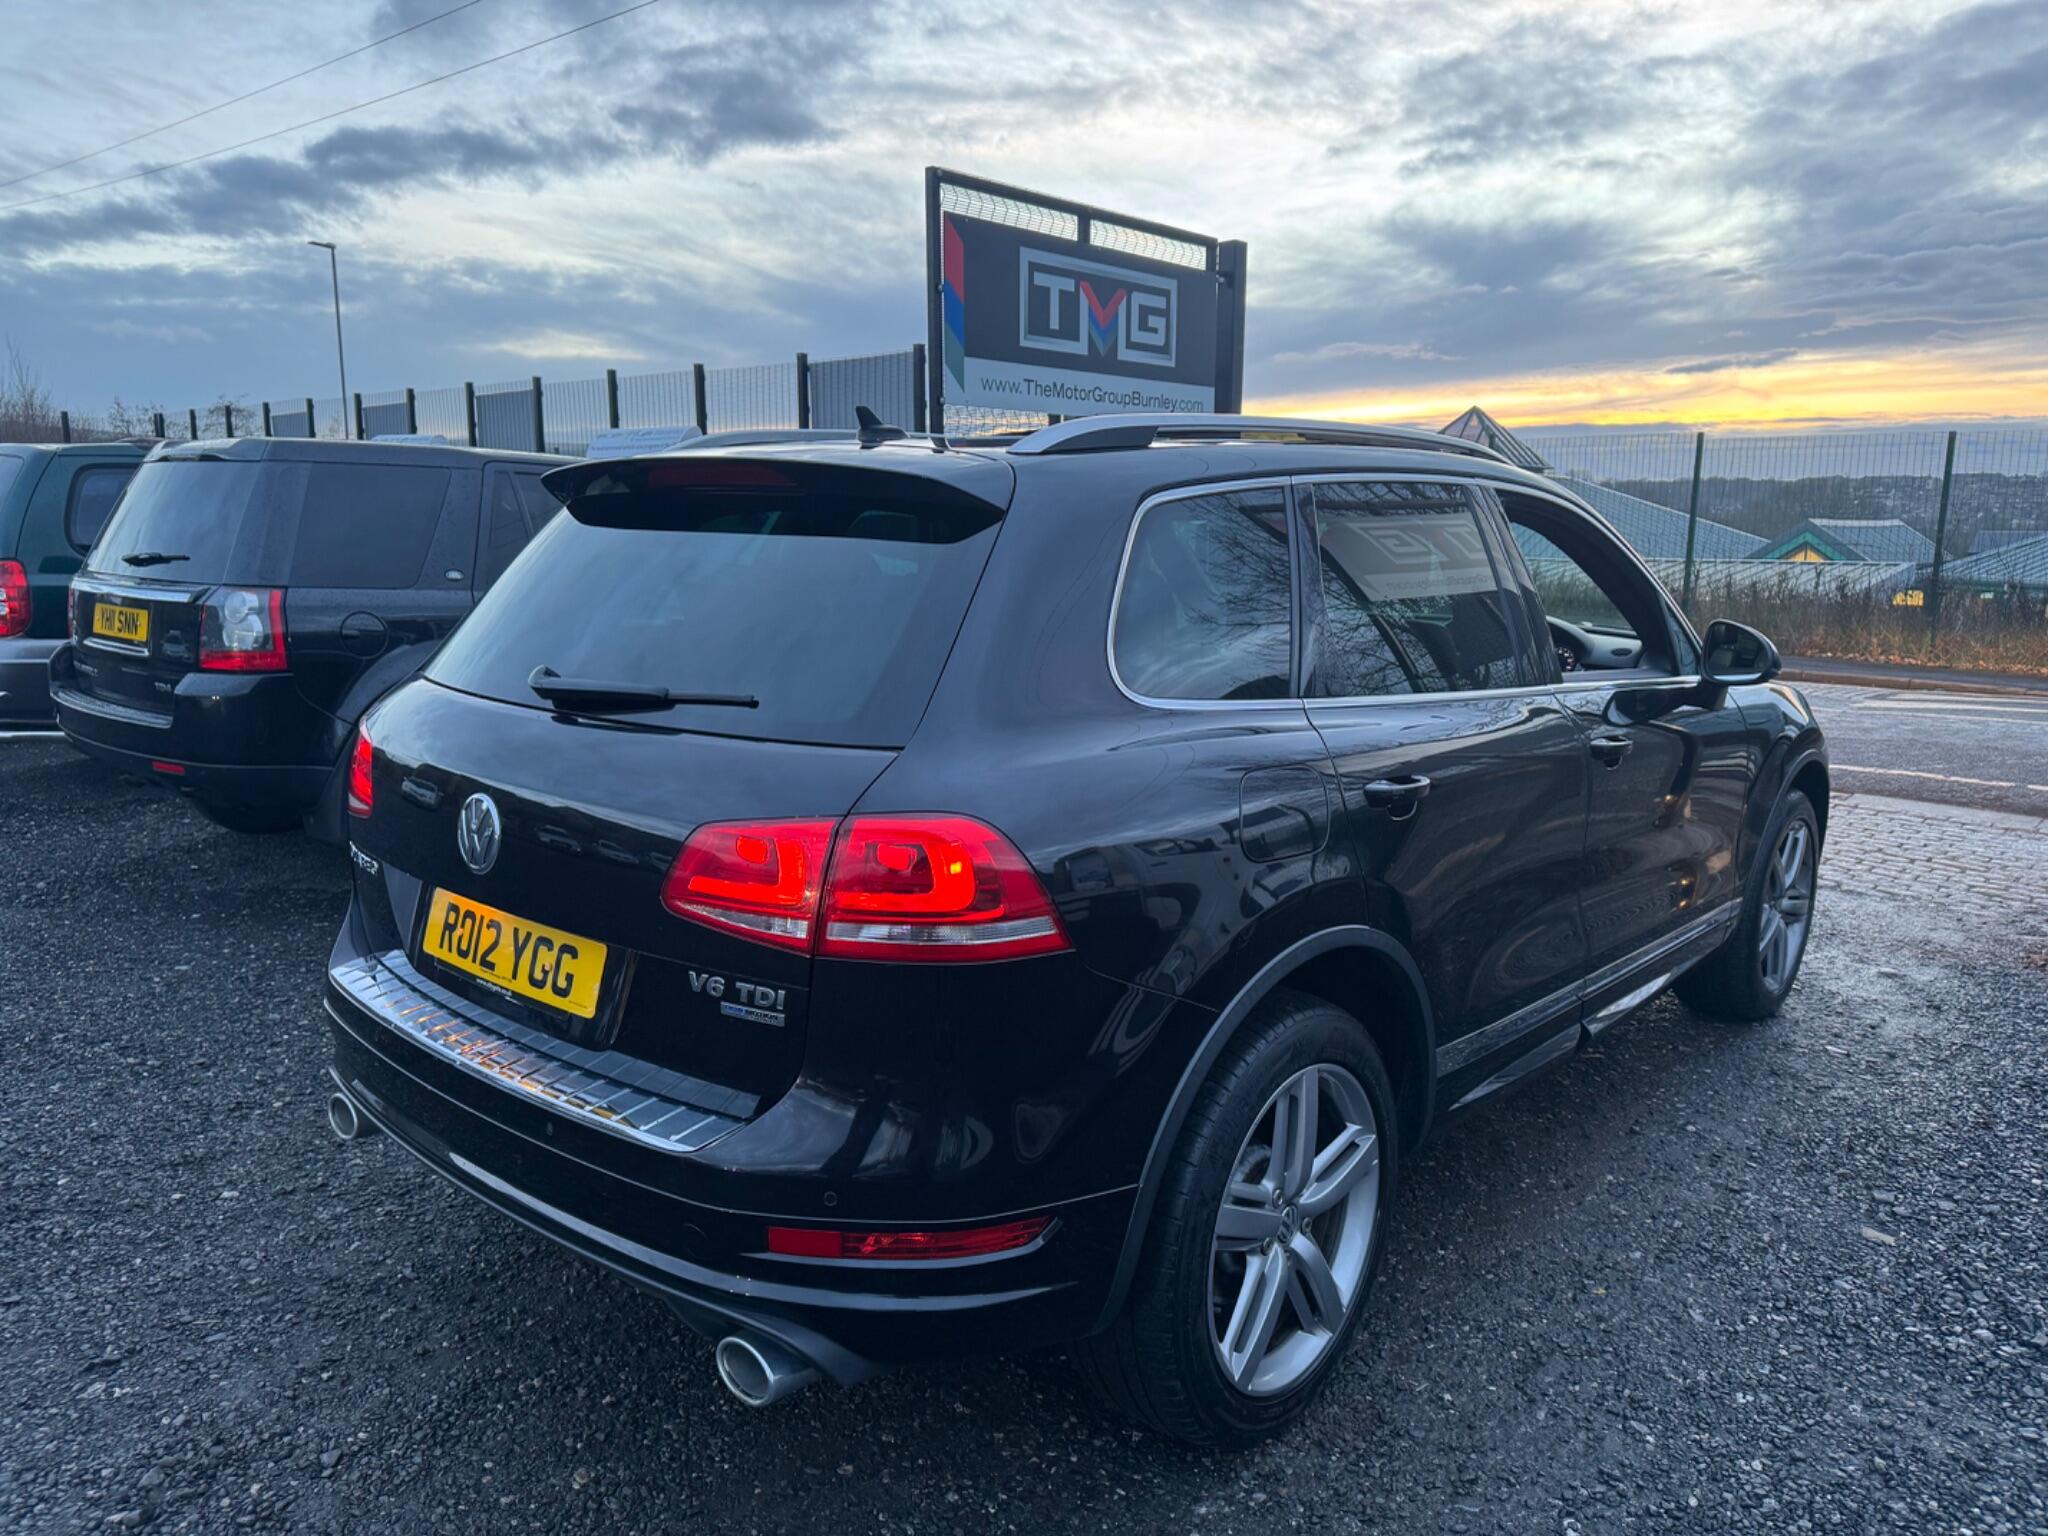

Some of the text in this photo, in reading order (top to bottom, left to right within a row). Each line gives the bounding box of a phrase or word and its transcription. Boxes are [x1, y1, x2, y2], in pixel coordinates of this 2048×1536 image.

[1033, 271, 1167, 357] TMG
[981, 378, 1204, 413] www.TheMotorGroupBurnley.com
[439, 901, 579, 999] RO12 YGG
[688, 970, 786, 1010] V6 TDI
